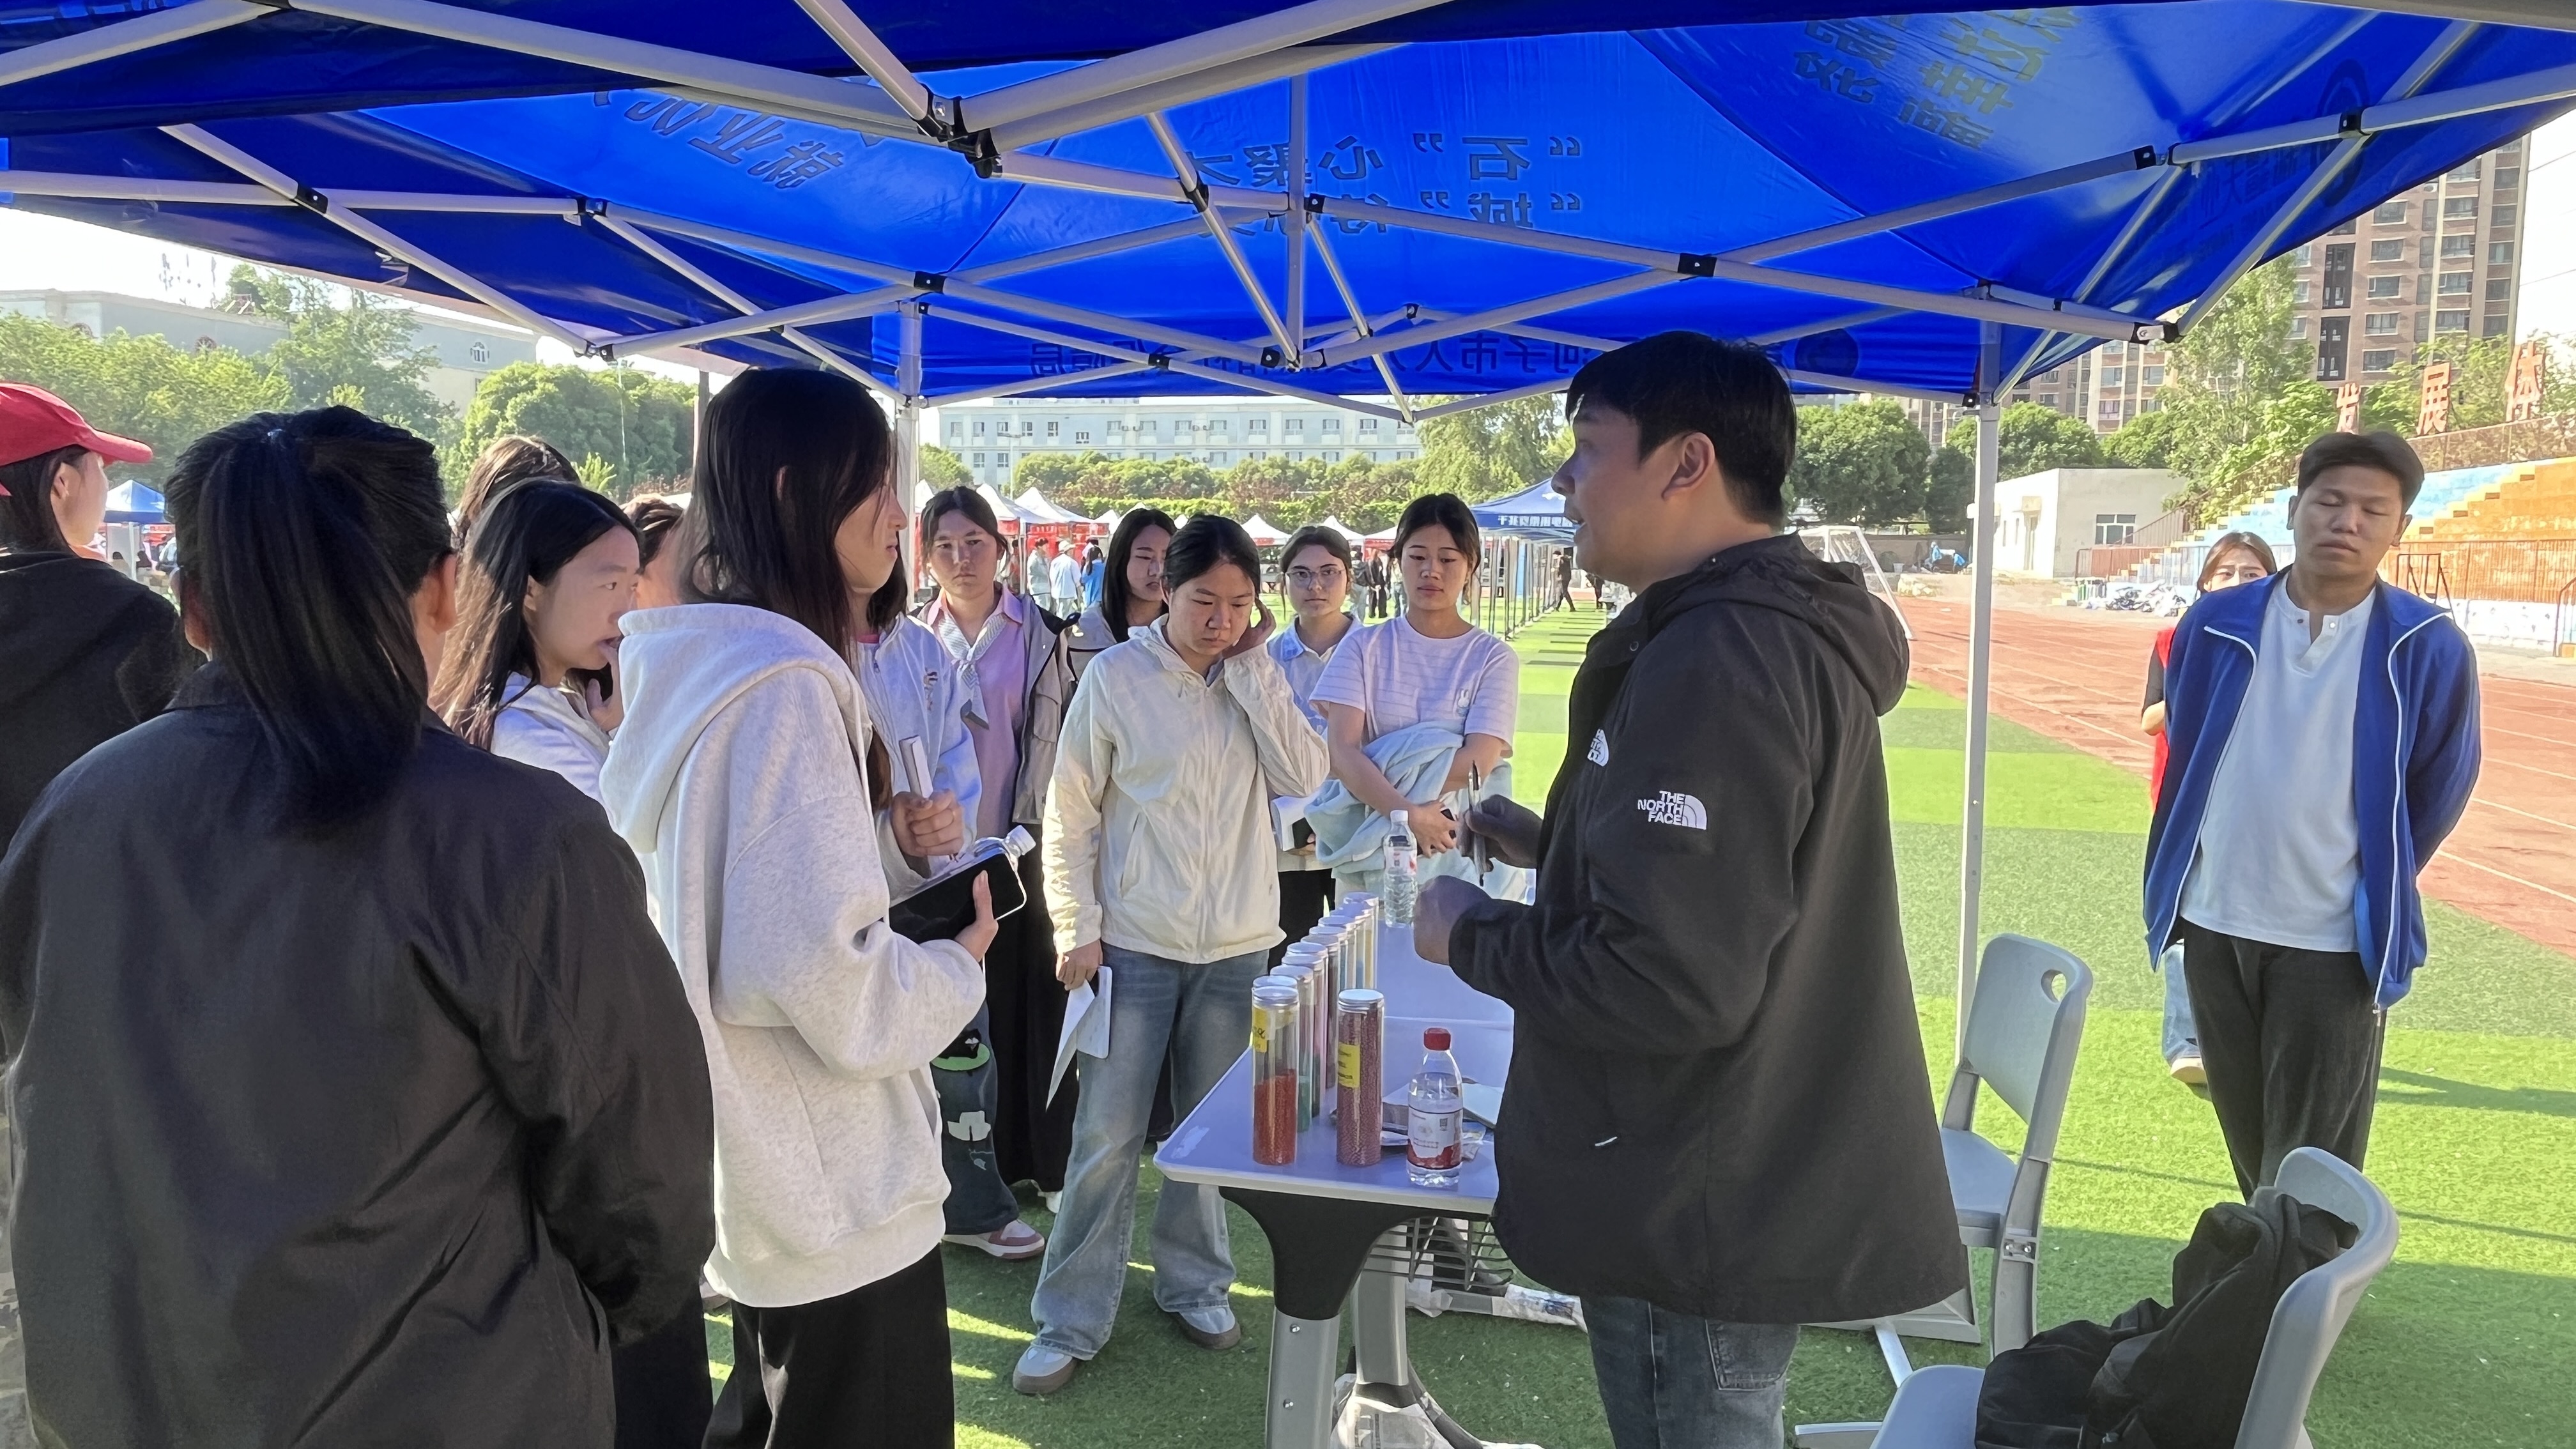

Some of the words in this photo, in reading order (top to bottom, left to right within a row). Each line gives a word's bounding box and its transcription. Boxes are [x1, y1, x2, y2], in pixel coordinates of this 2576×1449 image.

[1659, 790, 1685, 804] THE
[1637, 799, 1684, 816] NORTH
[1648, 811, 1682, 826] FACE
